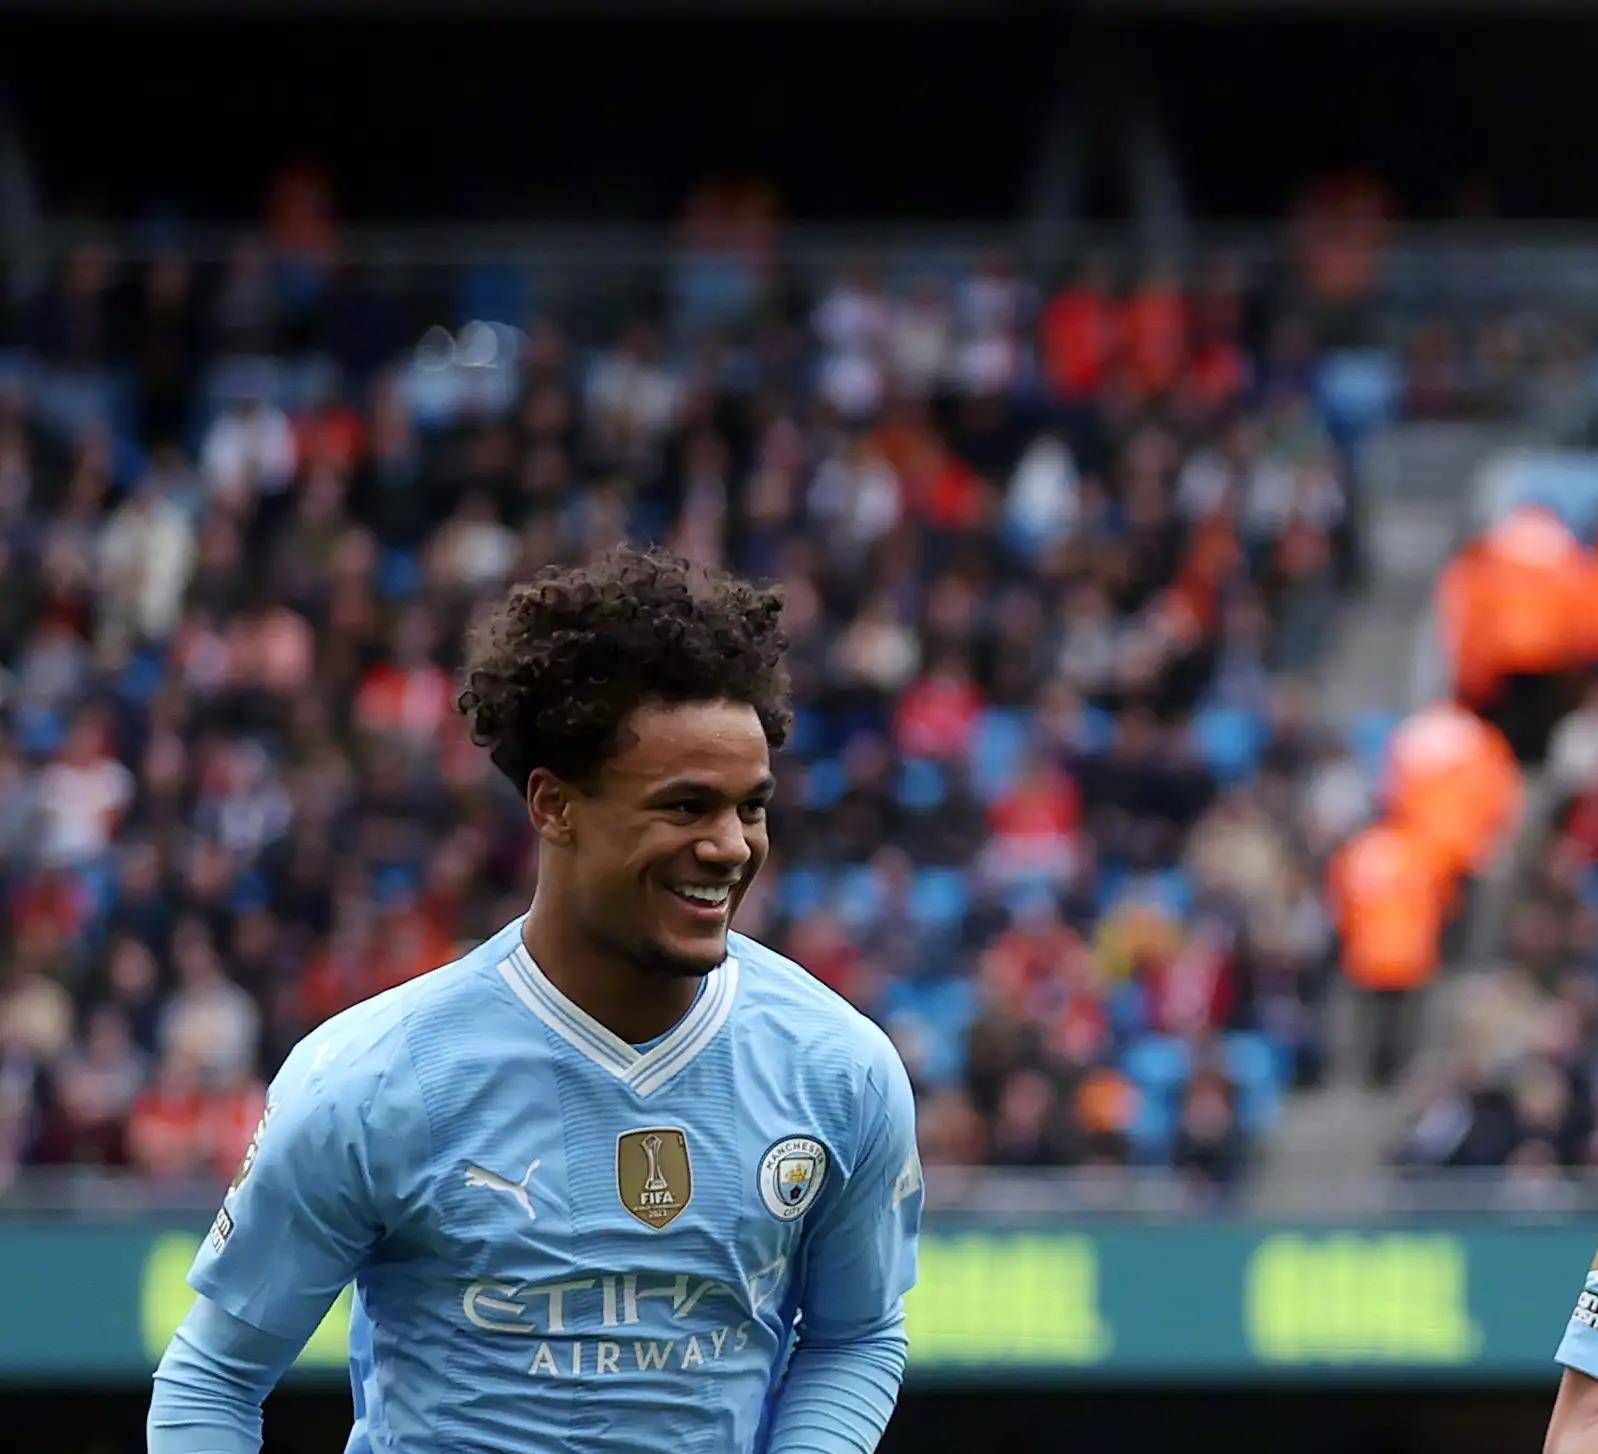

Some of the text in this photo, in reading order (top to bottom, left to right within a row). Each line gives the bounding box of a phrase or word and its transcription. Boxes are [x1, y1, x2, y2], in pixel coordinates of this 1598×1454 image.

[766, 1142, 824, 1170] MANCHESTER
[640, 1191, 674, 1205] FIFA
[528, 1319, 750, 1376] AIRWAYS
